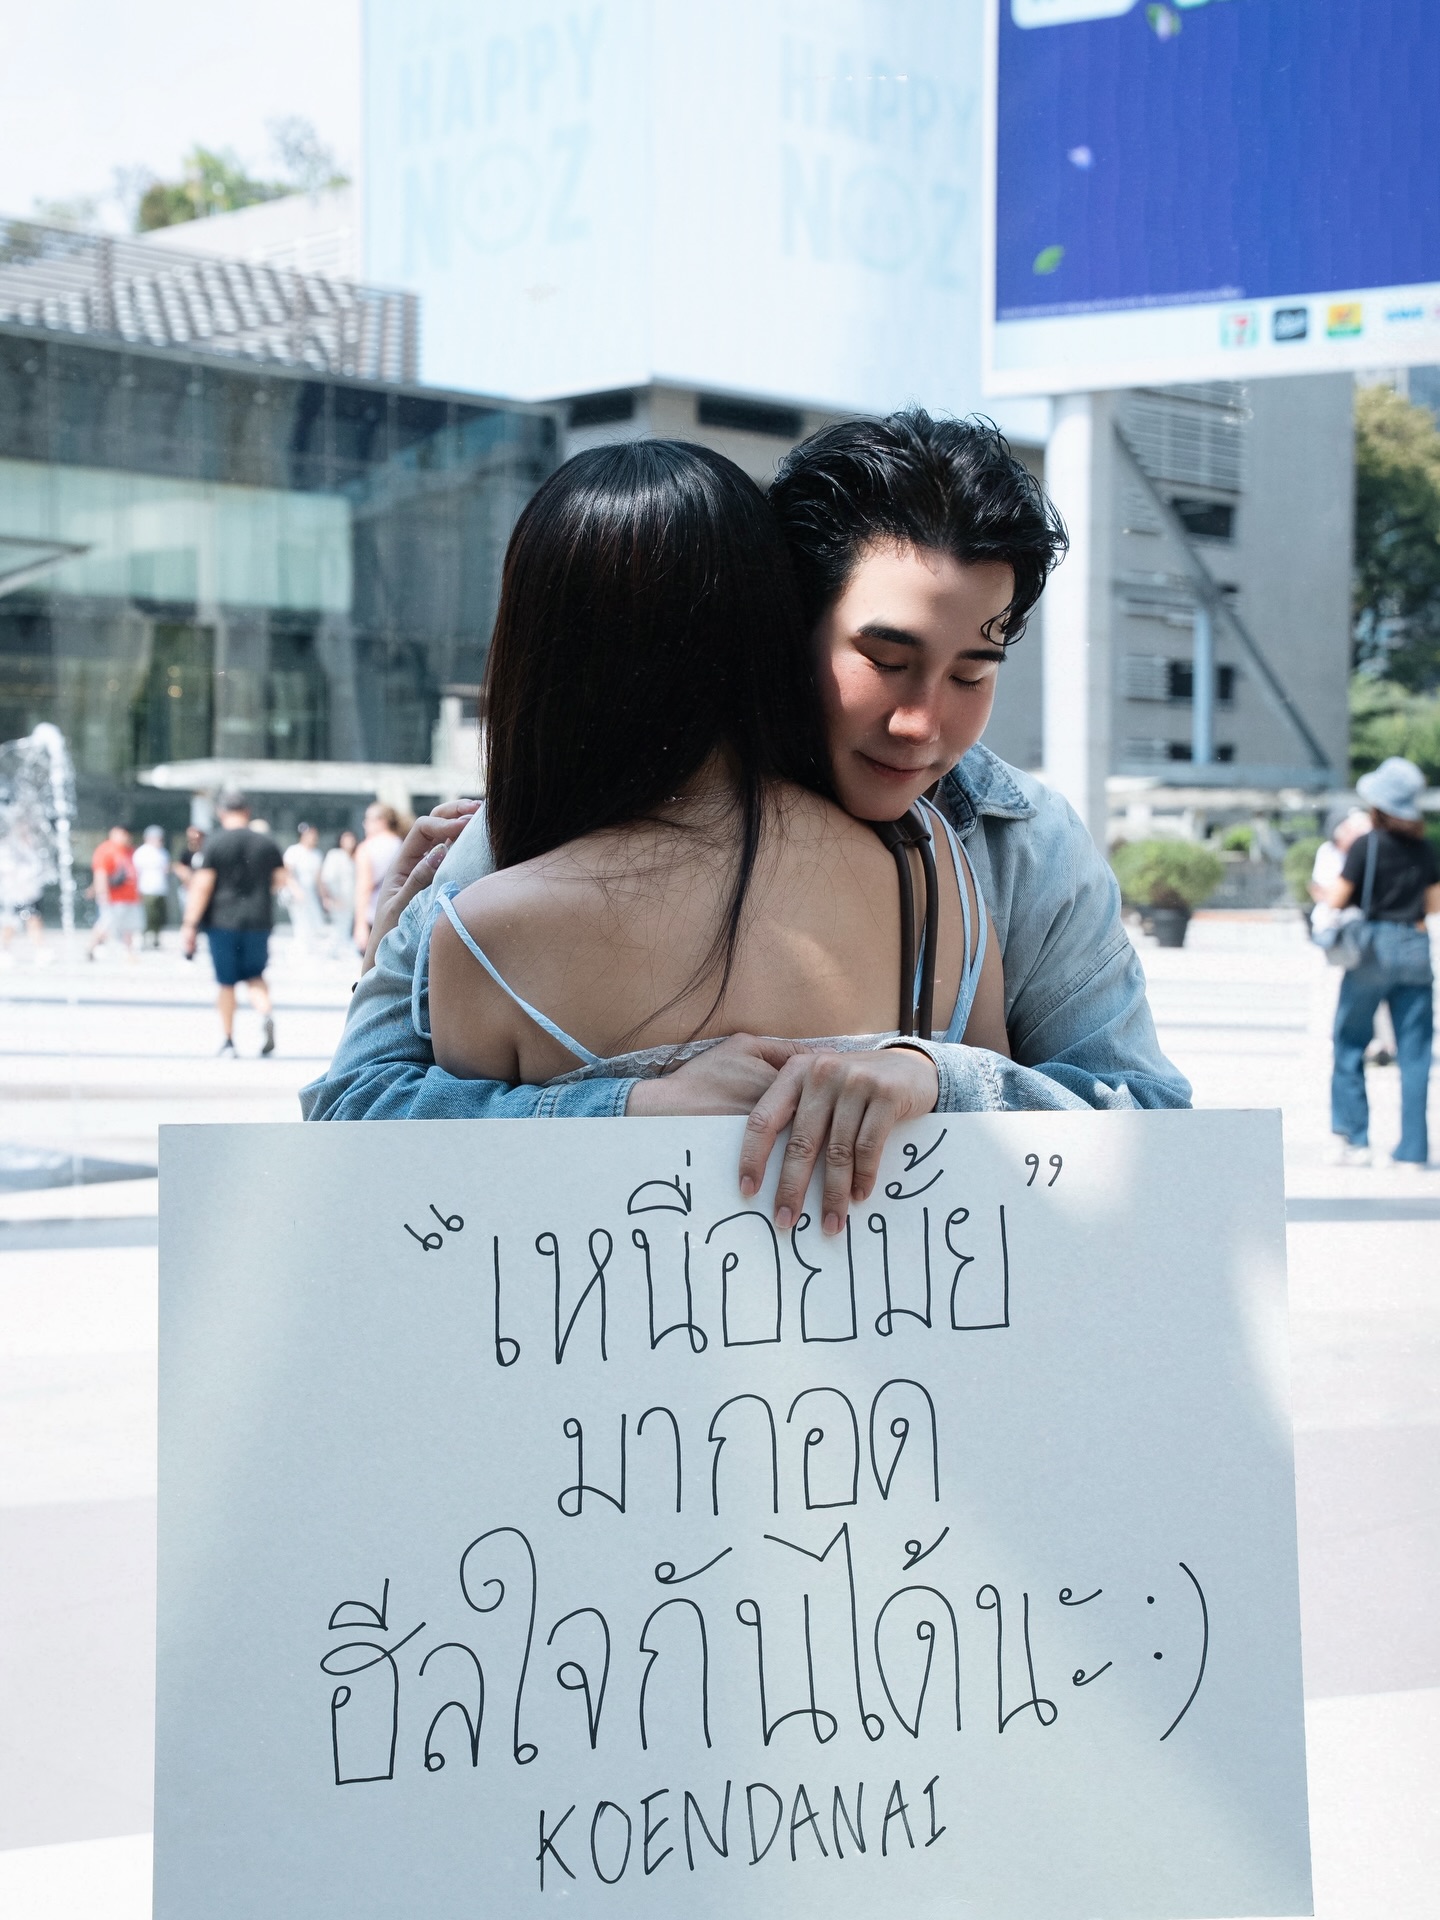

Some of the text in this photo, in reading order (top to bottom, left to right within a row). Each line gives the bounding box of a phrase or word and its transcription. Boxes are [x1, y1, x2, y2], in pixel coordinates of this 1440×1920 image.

[398, 3, 606, 148] HAPPY
[780, 32, 980, 168] HAPPY
[557, 1378, 940, 1518] มากอด
[535, 1774, 948, 1893] KOENDANAI
